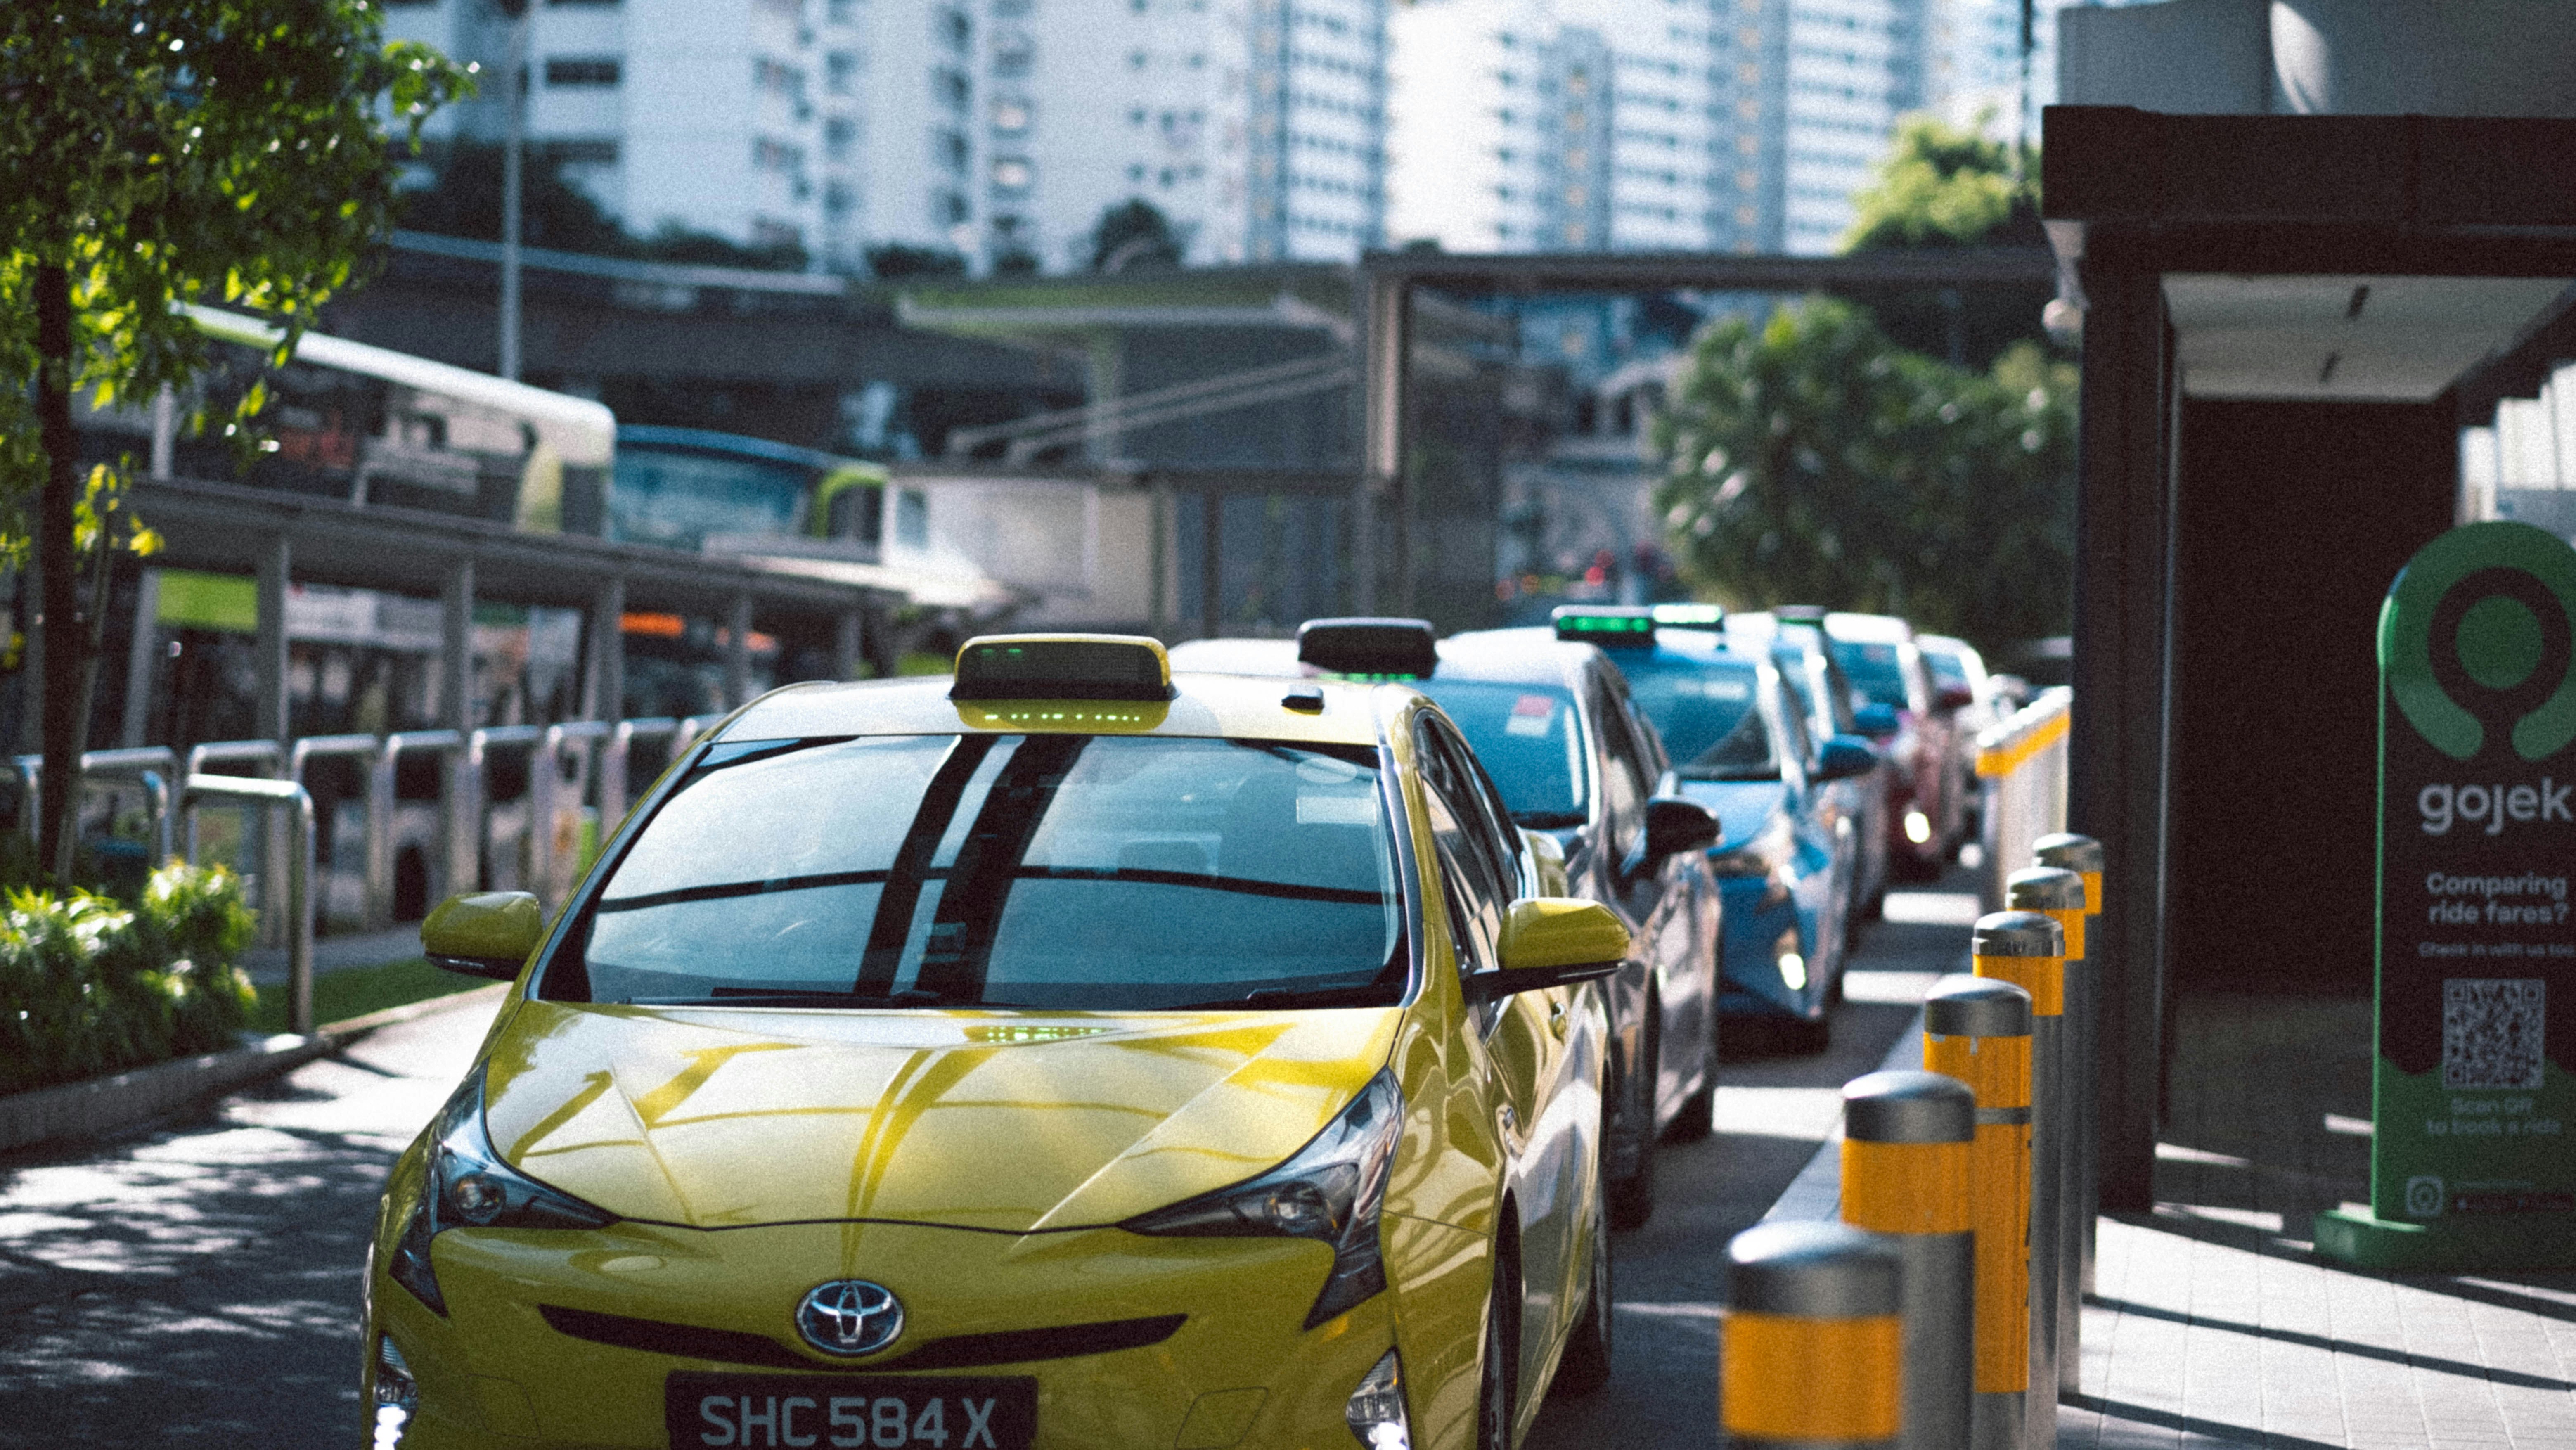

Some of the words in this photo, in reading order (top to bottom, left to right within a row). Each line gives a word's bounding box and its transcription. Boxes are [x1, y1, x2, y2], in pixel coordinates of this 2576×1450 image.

[2418, 776, 2573, 835] gojek
[2426, 871, 2567, 900] Comparing
[2429, 900, 2479, 924] ride
[2485, 900, 2569, 924] fares?
[699, 1396, 817, 1447] SHC
[829, 1396, 949, 1448] 584
[961, 1398, 997, 1448] X
